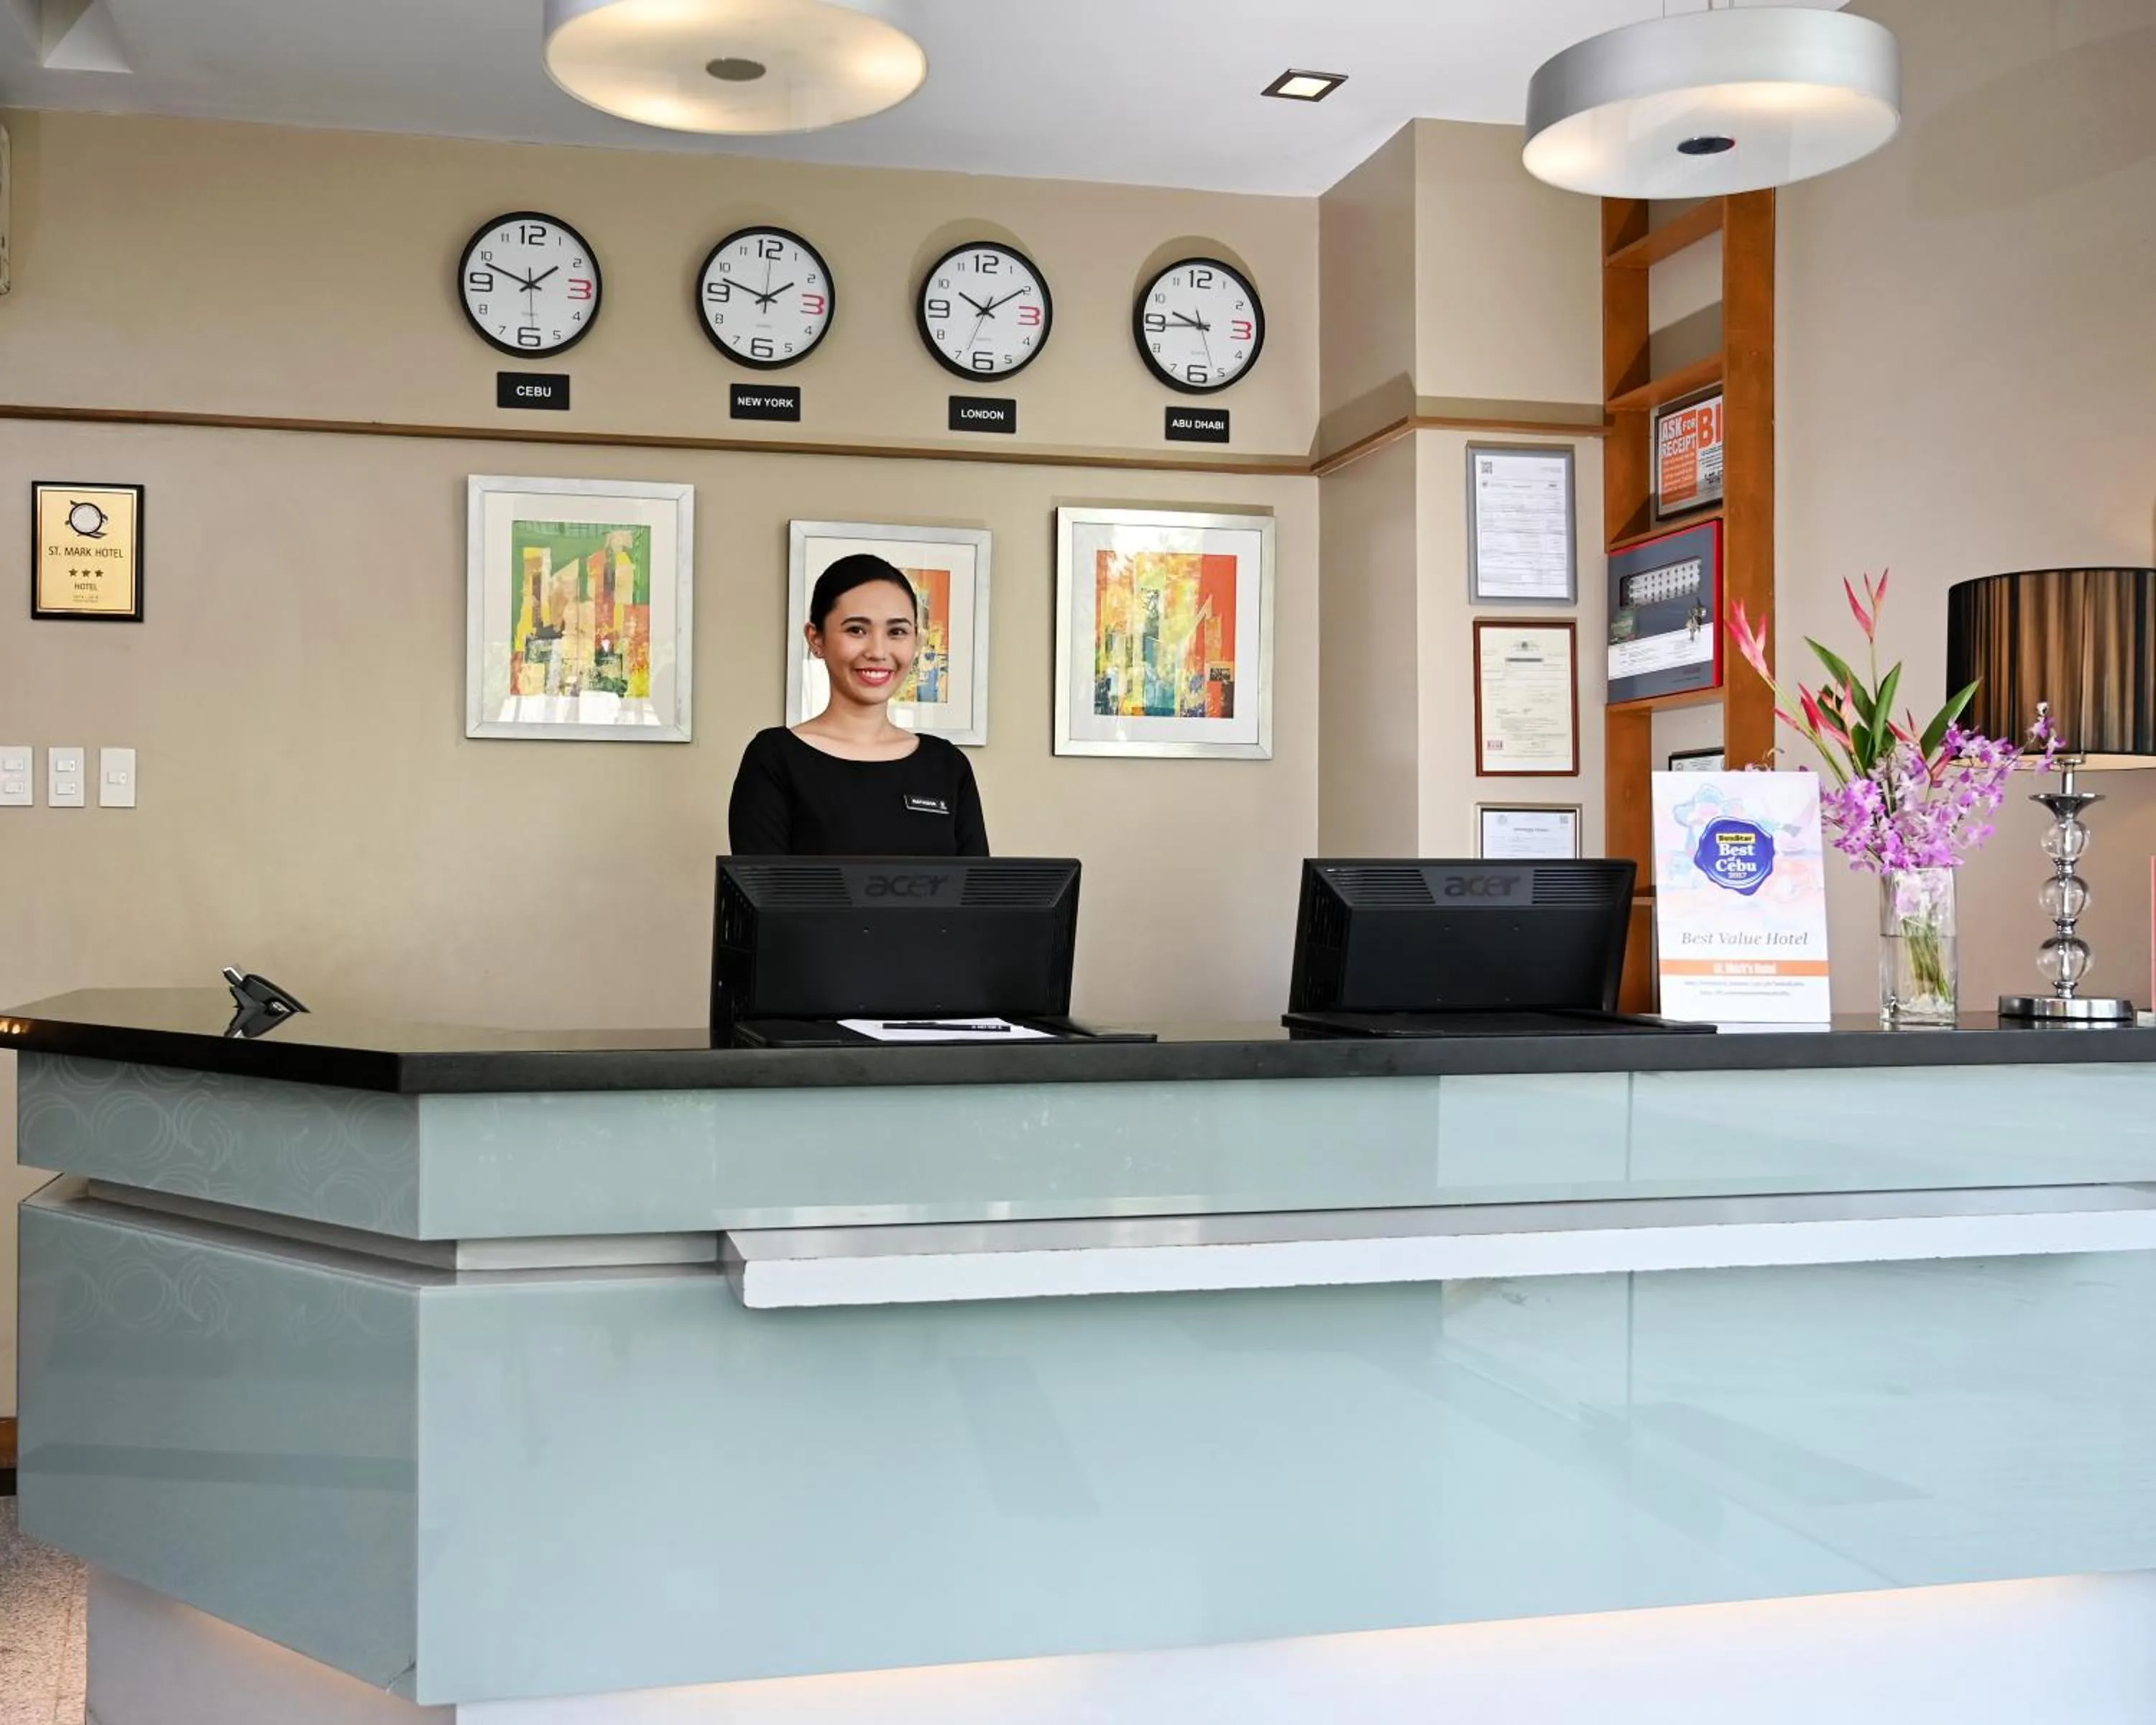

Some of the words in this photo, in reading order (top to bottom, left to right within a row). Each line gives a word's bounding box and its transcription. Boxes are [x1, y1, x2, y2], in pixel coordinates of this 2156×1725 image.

[501, 233, 510, 242] 11
[519, 225, 546, 246] 12
[481, 251, 492, 260] 10
[740, 246, 747, 255] 11
[757, 239, 783, 261] 12
[573, 259, 581, 267] 2
[720, 262, 730, 272] 10
[975, 254, 999, 273] 12
[470, 272, 493, 292] 9
[808, 274, 815, 283] 2
[939, 279, 949, 289] 10
[1173, 277, 1179, 286] 11
[1189, 270, 1212, 289] 12
[568, 279, 592, 300] 3
[707, 282, 729, 303] 9
[1023, 286, 1031, 295] 2
[1155, 293, 1165, 303] 10
[479, 305, 487, 314] 8
[801, 294, 824, 315] 3
[929, 299, 950, 318] 9
[1235, 300, 1243, 309] 2
[573, 312, 580, 321] 4
[716, 313, 723, 323] 8
[1018, 306, 1040, 325] 3
[1146, 313, 1166, 332] 9
[553, 331, 561, 340] 5
[805, 326, 812, 335] 4
[937, 329, 944, 339] 8
[1230, 321, 1252, 339] 3
[517, 327, 540, 346] 6
[733, 336, 740, 344] 7
[750, 337, 773, 358] 6
[785, 344, 792, 352] 5
[1153, 343, 1161, 352] 8
[954, 351, 962, 359] 7
[973, 351, 993, 370] 6
[1005, 355, 1012, 364] 5
[1187, 365, 1207, 383] 6
[1217, 368, 1225, 377] 5
[517, 385, 551, 397] CEBU
[737, 397, 762, 406] NEW
[764, 398, 793, 408] YORK
[961, 409, 1003, 420] LONDON
[1172, 419, 1192, 428] ABU
[1194, 420, 1223, 430] DHABI
[1662, 417, 1682, 442] ASK
[1662, 434, 1696, 456] RECEIPT
[48, 546, 60, 556] ST.
[65, 547, 91, 556] MARK
[95, 548, 124, 558] HOTEL
[1719, 844, 1756, 856] Best
[1715, 859, 1756, 872] Cebu
[864, 875, 949, 898] acer
[1445, 875, 1521, 897] acer
[1682, 932, 1713, 944] Best
[1719, 932, 1761, 945] Value
[1766, 932, 1808, 945] Hotel
